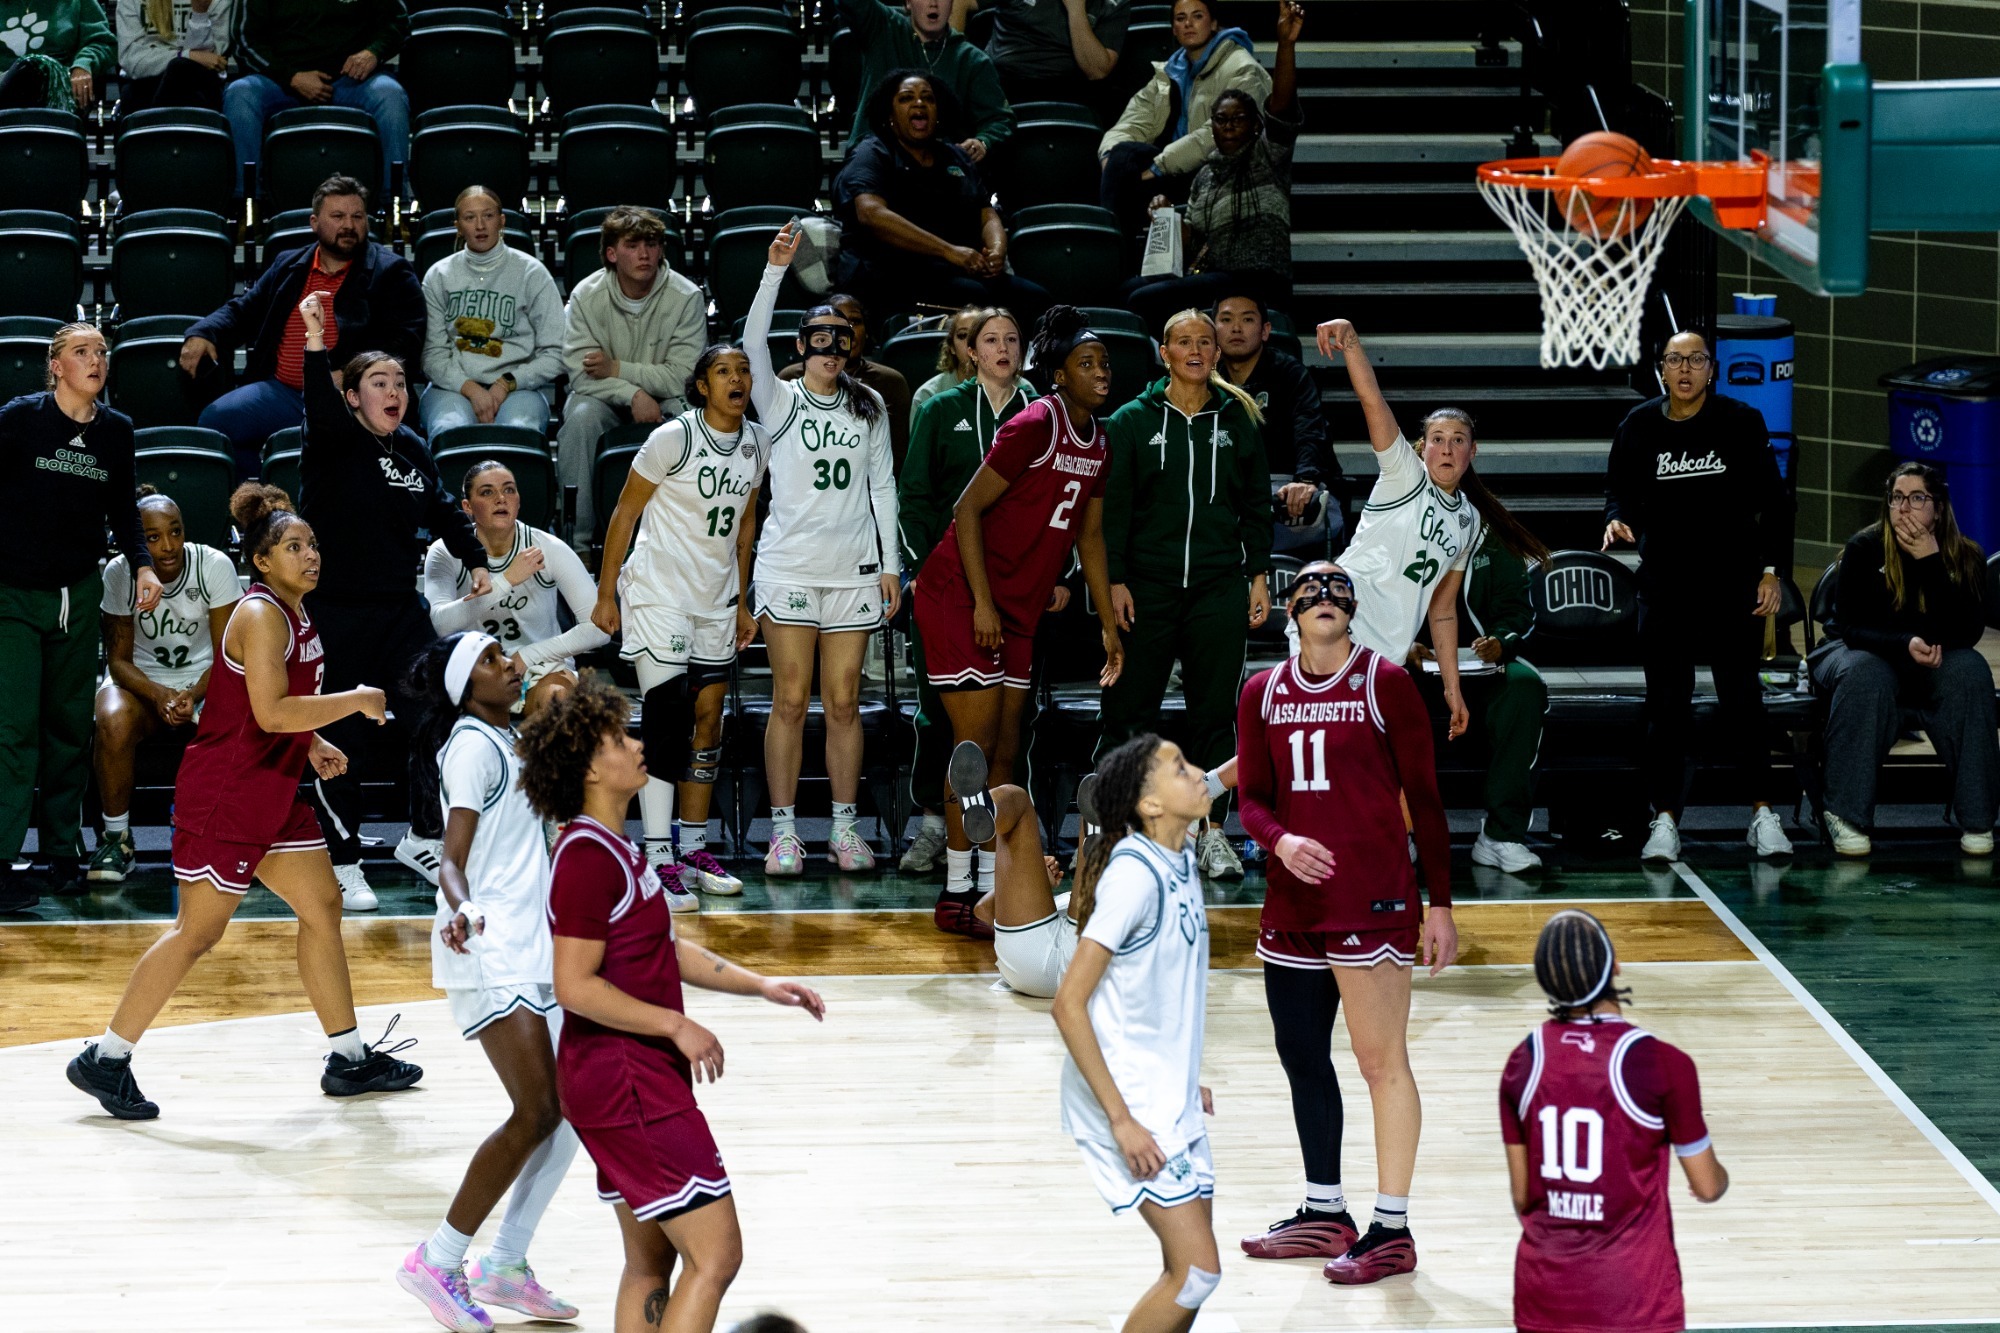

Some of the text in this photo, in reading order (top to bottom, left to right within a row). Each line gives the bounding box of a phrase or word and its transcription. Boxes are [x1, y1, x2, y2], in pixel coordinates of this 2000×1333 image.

[444, 289, 515, 328] OHIO
[801, 418, 860, 452] Ohio
[35, 456, 108, 481] BOBCATS
[55, 448, 97, 466] OHIO
[813, 458, 851, 490] 30
[1656, 450, 1727, 480] Bobcats
[698, 465, 751, 499] Ohio
[706, 506, 735, 537] 13
[1049, 480, 1081, 530] 2
[1420, 505, 1458, 557] Ohio
[1402, 549, 1439, 588] 20
[1545, 566, 1613, 612] OHIO
[138, 608, 199, 640] Ohio
[482, 617, 522, 642] 23
[153, 645, 192, 669] 22
[1288, 729, 1331, 791] 11
[1538, 1104, 1605, 1184] 10
